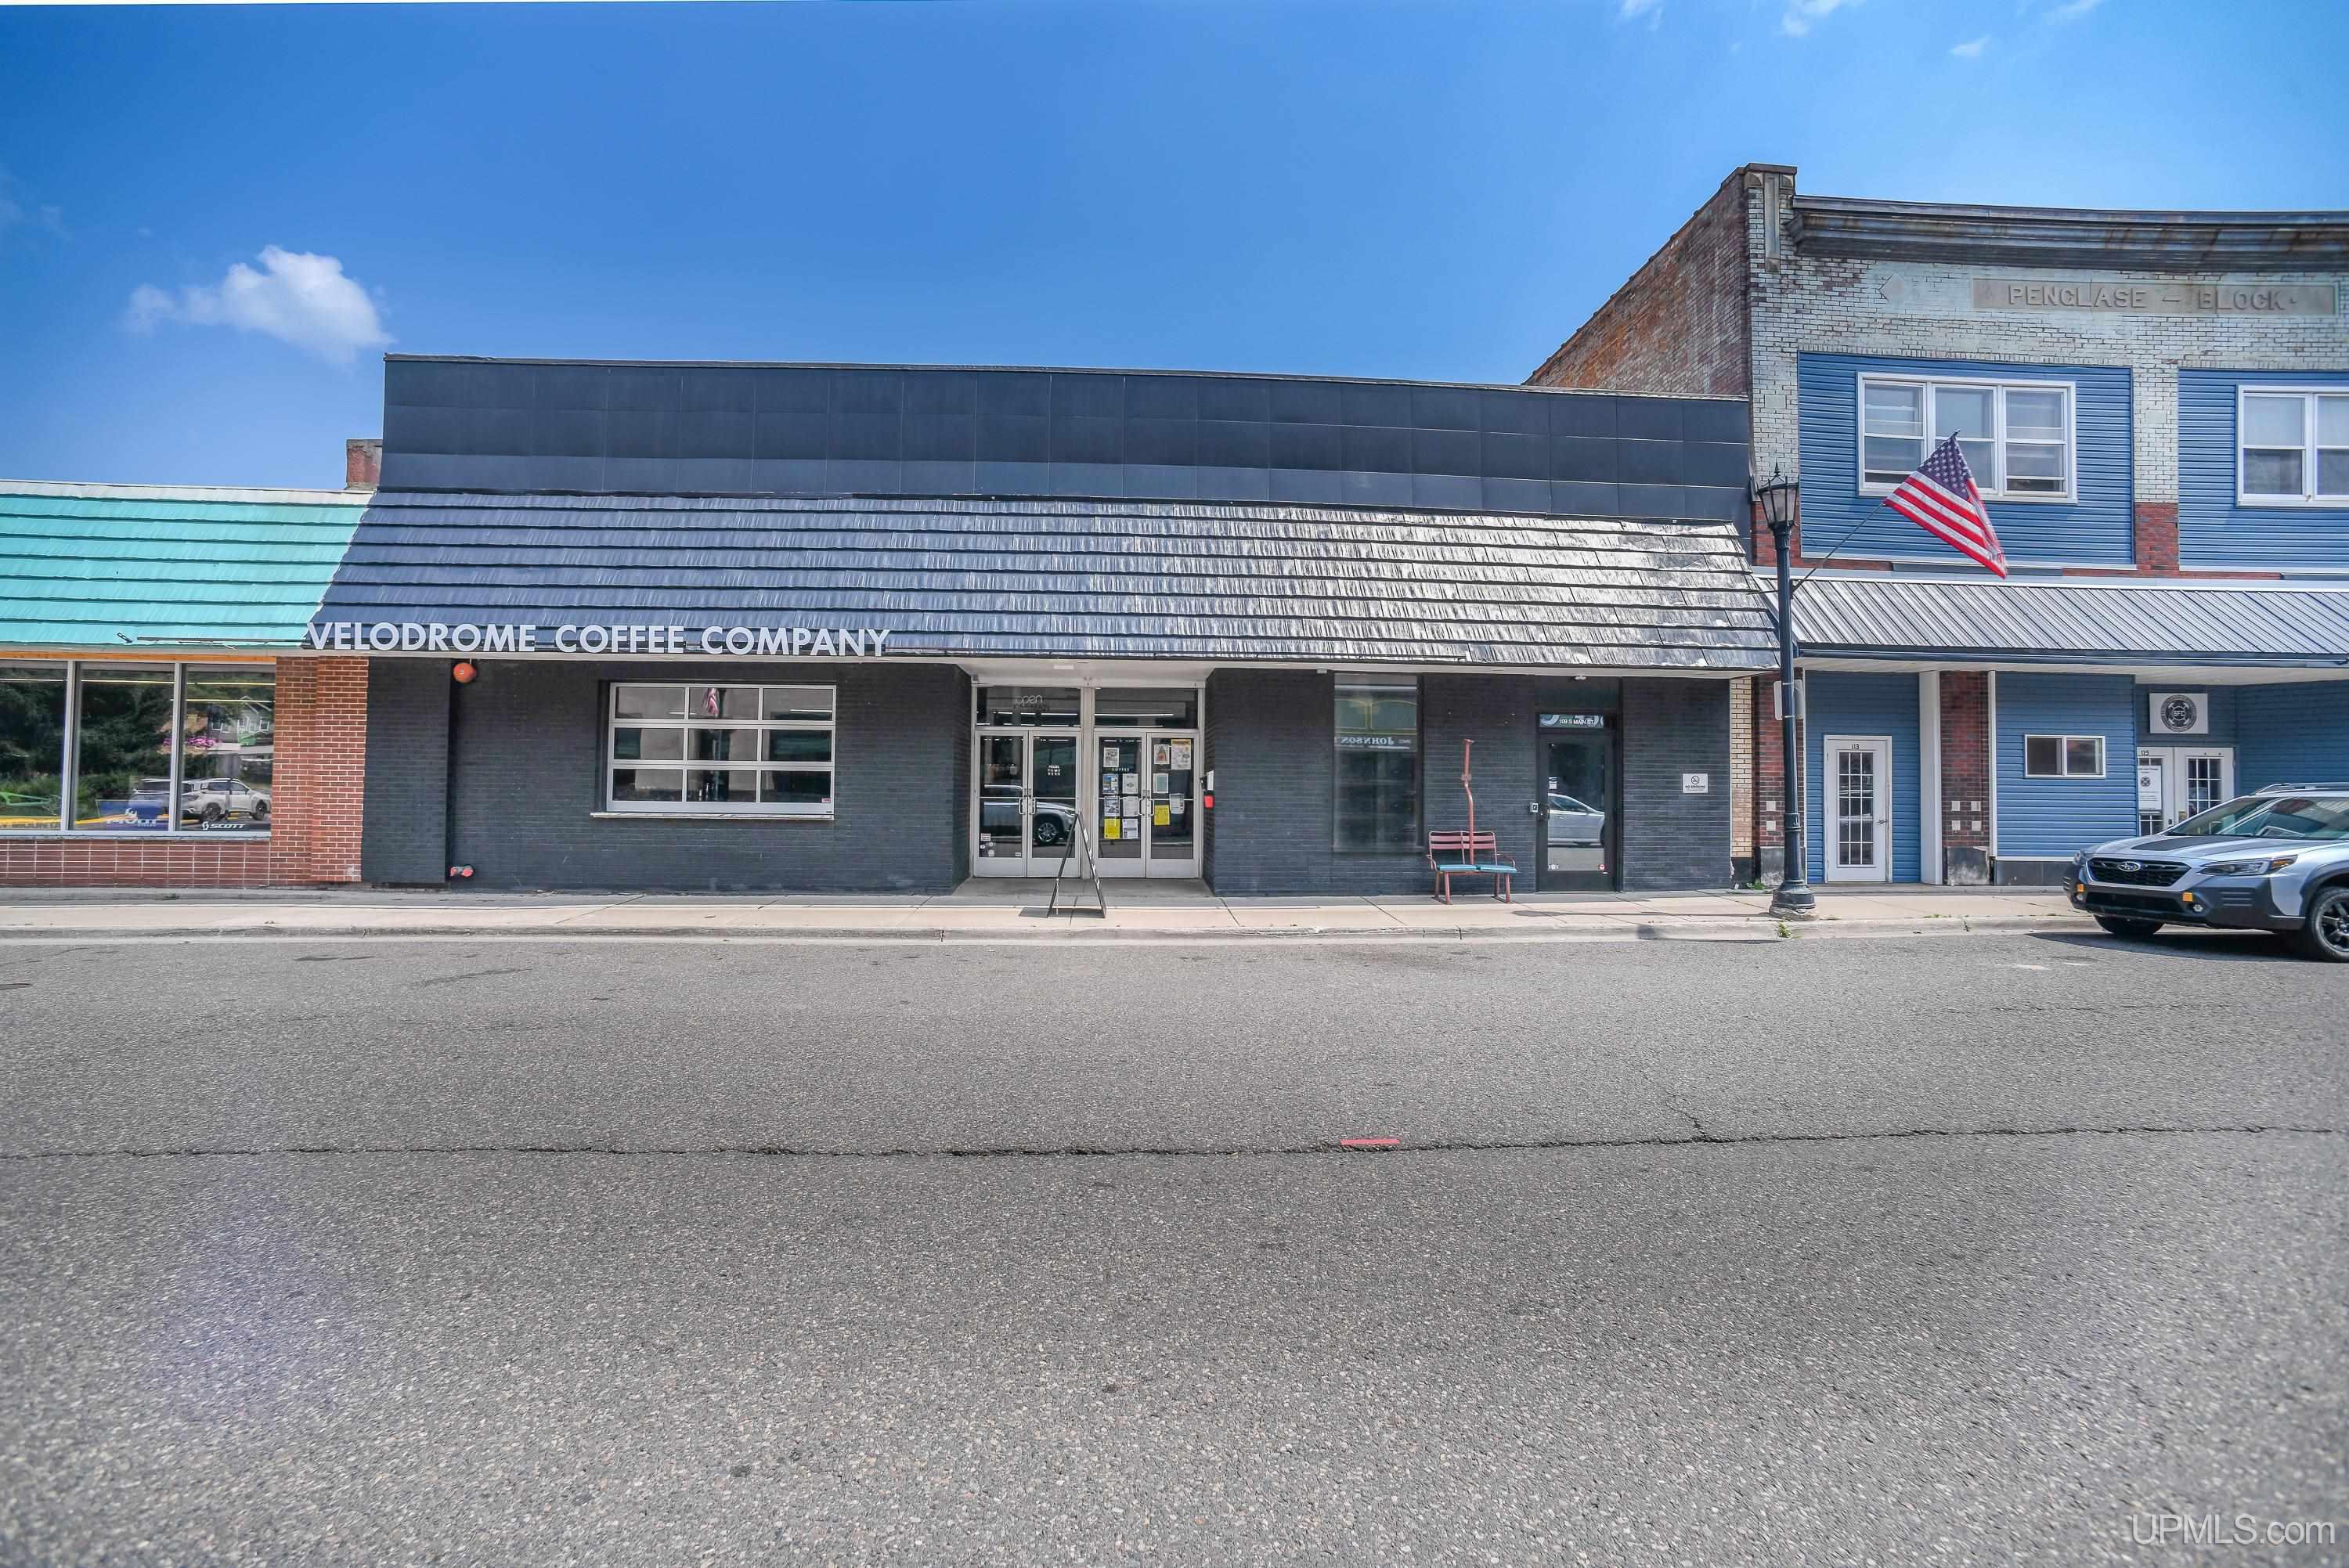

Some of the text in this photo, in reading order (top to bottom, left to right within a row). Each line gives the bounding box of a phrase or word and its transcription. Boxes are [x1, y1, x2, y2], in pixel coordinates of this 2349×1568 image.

[2198, 289, 2286, 311] BLOCK
[307, 622, 891, 657] VELODROME COFFEE COMPANY
